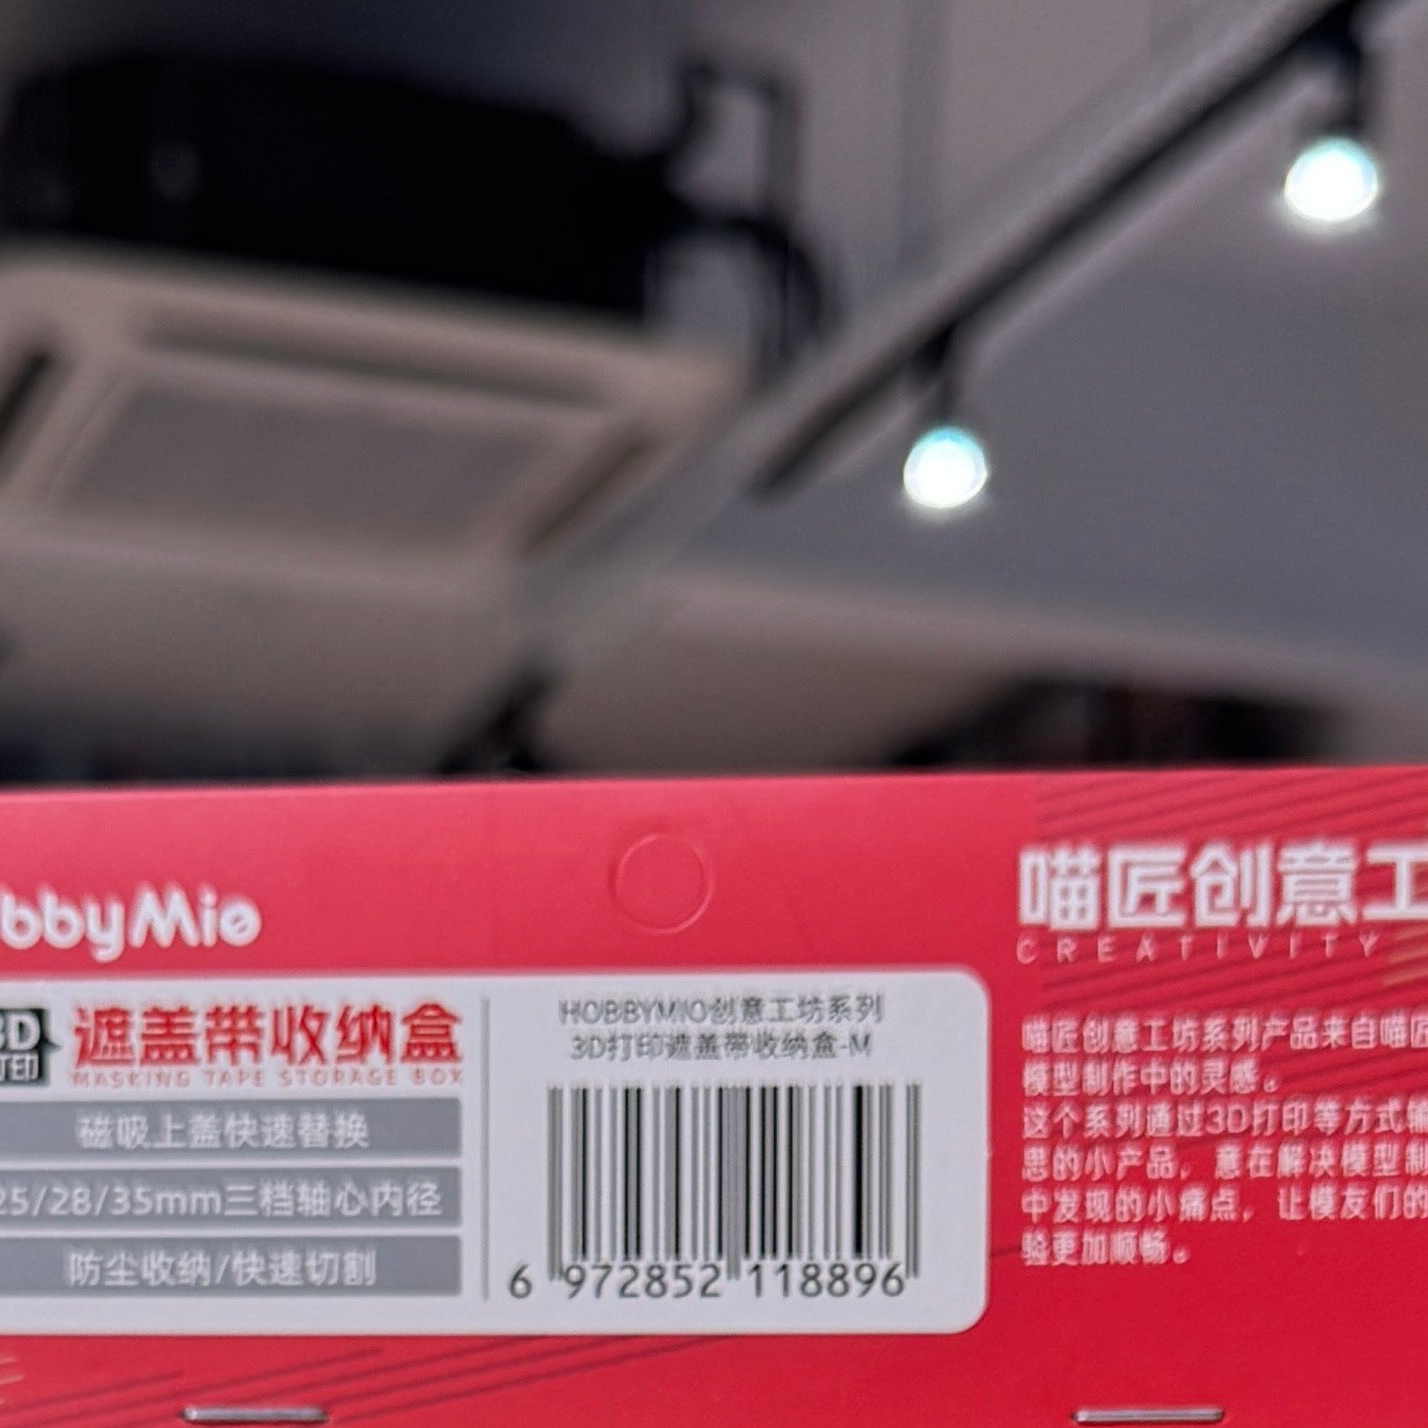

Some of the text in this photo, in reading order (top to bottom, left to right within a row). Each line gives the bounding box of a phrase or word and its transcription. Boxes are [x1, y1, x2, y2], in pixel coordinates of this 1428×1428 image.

[1016, 931, 1379, 964] CREATIVITY
[558, 994, 884, 1025] HOBBYMIO创意工坊系列
[74, 1002, 463, 1067] 遮盖带收纳盒
[571, 1029, 872, 1060] 3D打印遮盖带收纳盒-M
[73, 1067, 464, 1088] MASKING TAPE STORAGE BOX
[78, 1112, 370, 1151] 磁吸上盖快速替换
[69, 1248, 377, 1288] 防尘收纳/快速切割
[508, 1261, 906, 1299] 6 972852 118896
